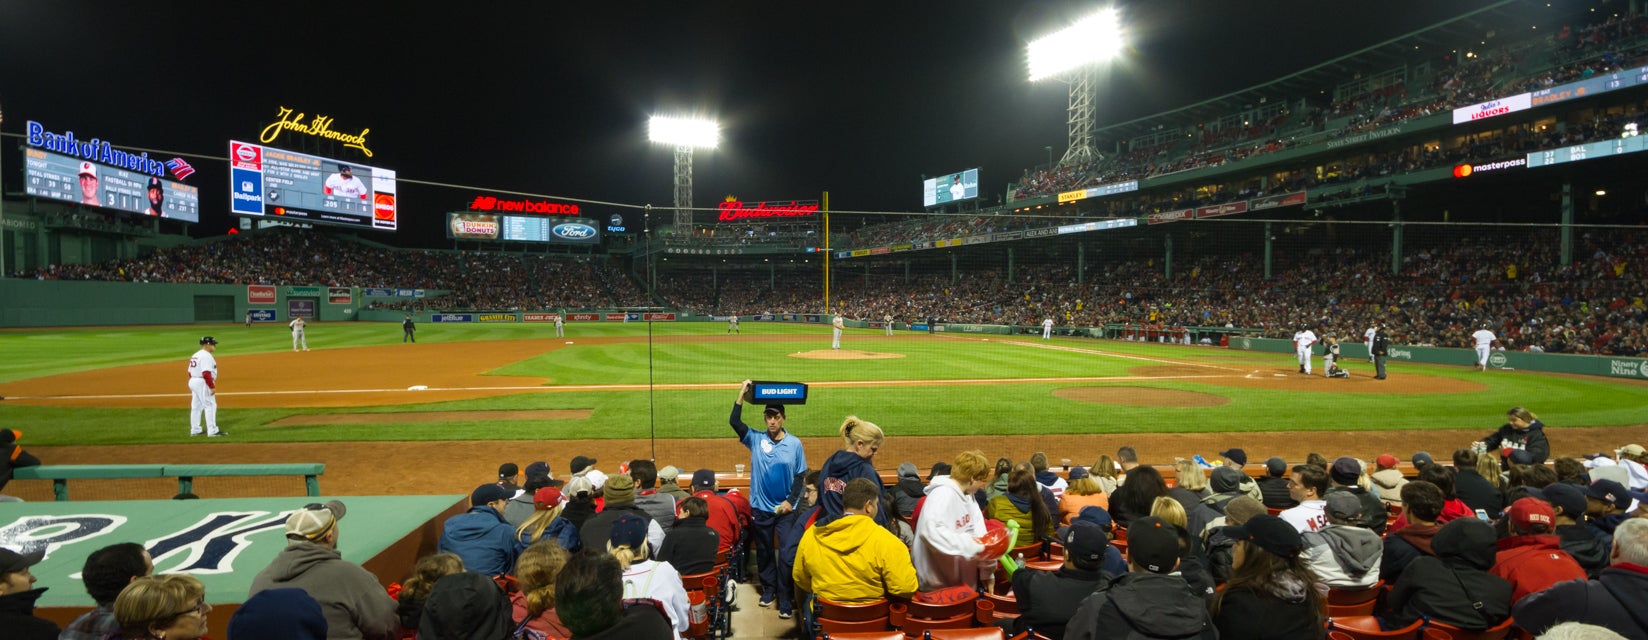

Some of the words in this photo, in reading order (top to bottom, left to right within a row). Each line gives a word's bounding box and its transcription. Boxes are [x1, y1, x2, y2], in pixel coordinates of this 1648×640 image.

[1610, 80, 1620, 88] 13
[1532, 90, 1571, 105] BRADLEY
[1471, 105, 1510, 120] LIQUORS
[260, 105, 310, 144] John
[308, 114, 374, 158] Hancock
[1369, 127, 1401, 140] PAVILION
[26, 120, 80, 157] Bank
[81, 138, 100, 160] of
[101, 141, 165, 177] America
[1570, 145, 1587, 154] BAL
[1570, 153, 1586, 161] BOS
[1473, 158, 1526, 173] masterpass
[105, 175, 127, 187] FASTBALL
[108, 193, 115, 206] 3
[233, 191, 262, 202] Ballpark
[1061, 192, 1083, 200] STANLEY
[497, 200, 525, 212] new
[525, 199, 579, 216] balance
[718, 200, 819, 221] Budweiser
[561, 225, 588, 237] Ford
[607, 225, 626, 233] tyco
[574, 313, 592, 321] xfinity
[1391, 348, 1411, 359] Spring
[1611, 360, 1639, 369] Ninety
[1611, 366, 1637, 375] Nine
